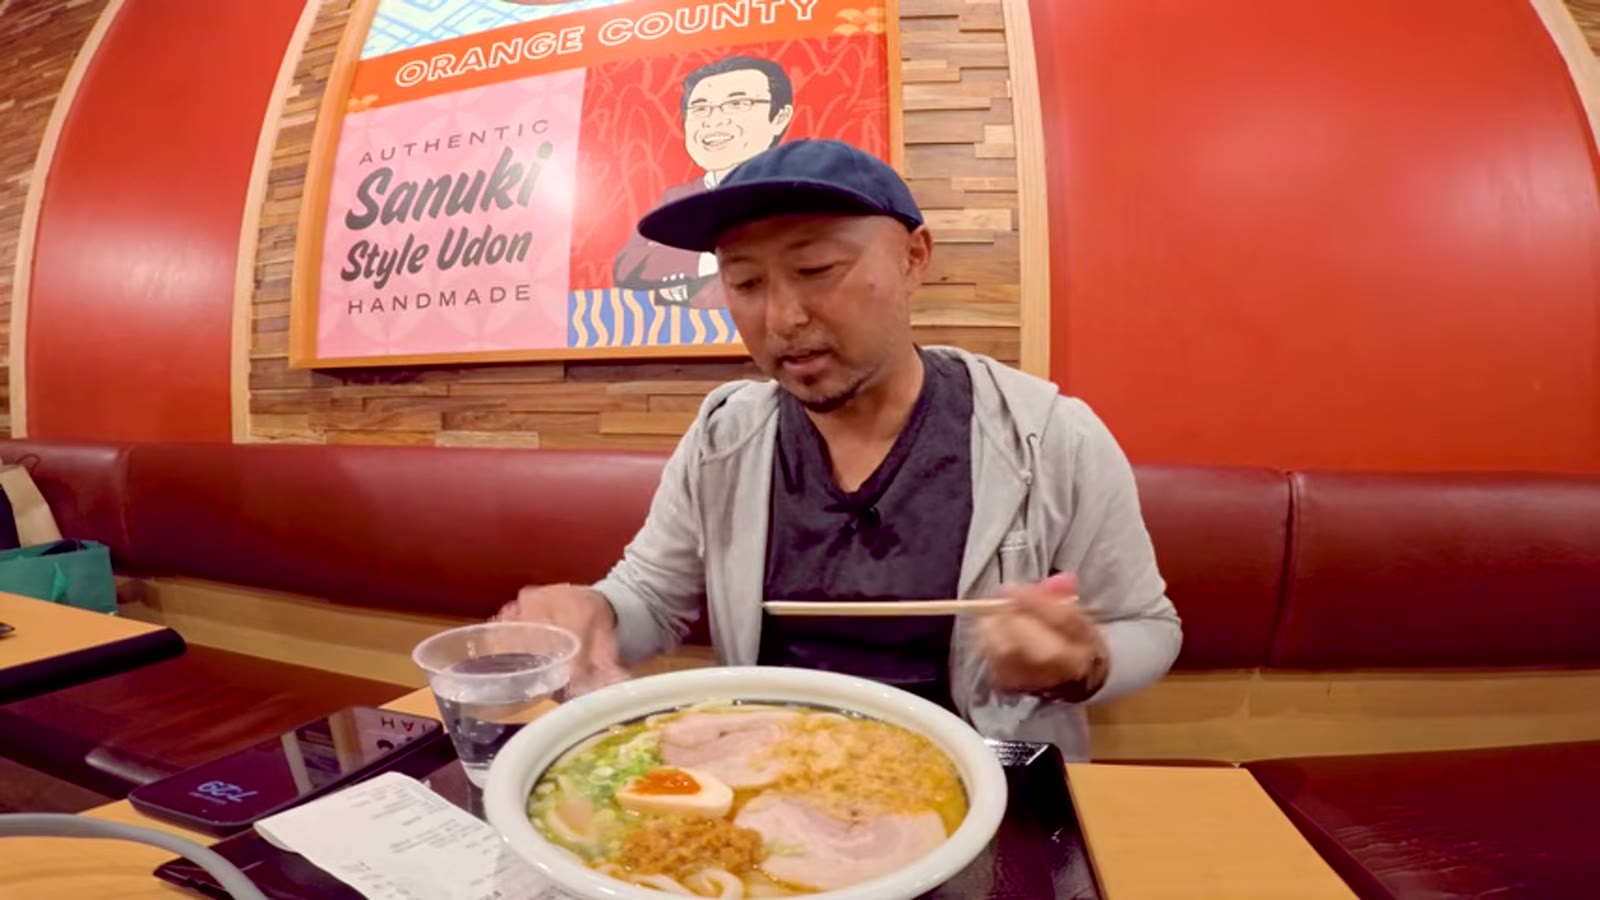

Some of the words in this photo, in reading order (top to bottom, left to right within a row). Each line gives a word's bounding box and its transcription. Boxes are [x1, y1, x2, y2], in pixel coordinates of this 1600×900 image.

[395, 27, 583, 87] ORANGE
[598, 0, 818, 46] COUNTY
[359, 119, 550, 165] AUTHENTIC
[344, 141, 553, 231] Sanuki
[340, 233, 430, 290] Style
[436, 224, 533, 271] Udon
[347, 284, 531, 315] HANDMADE
